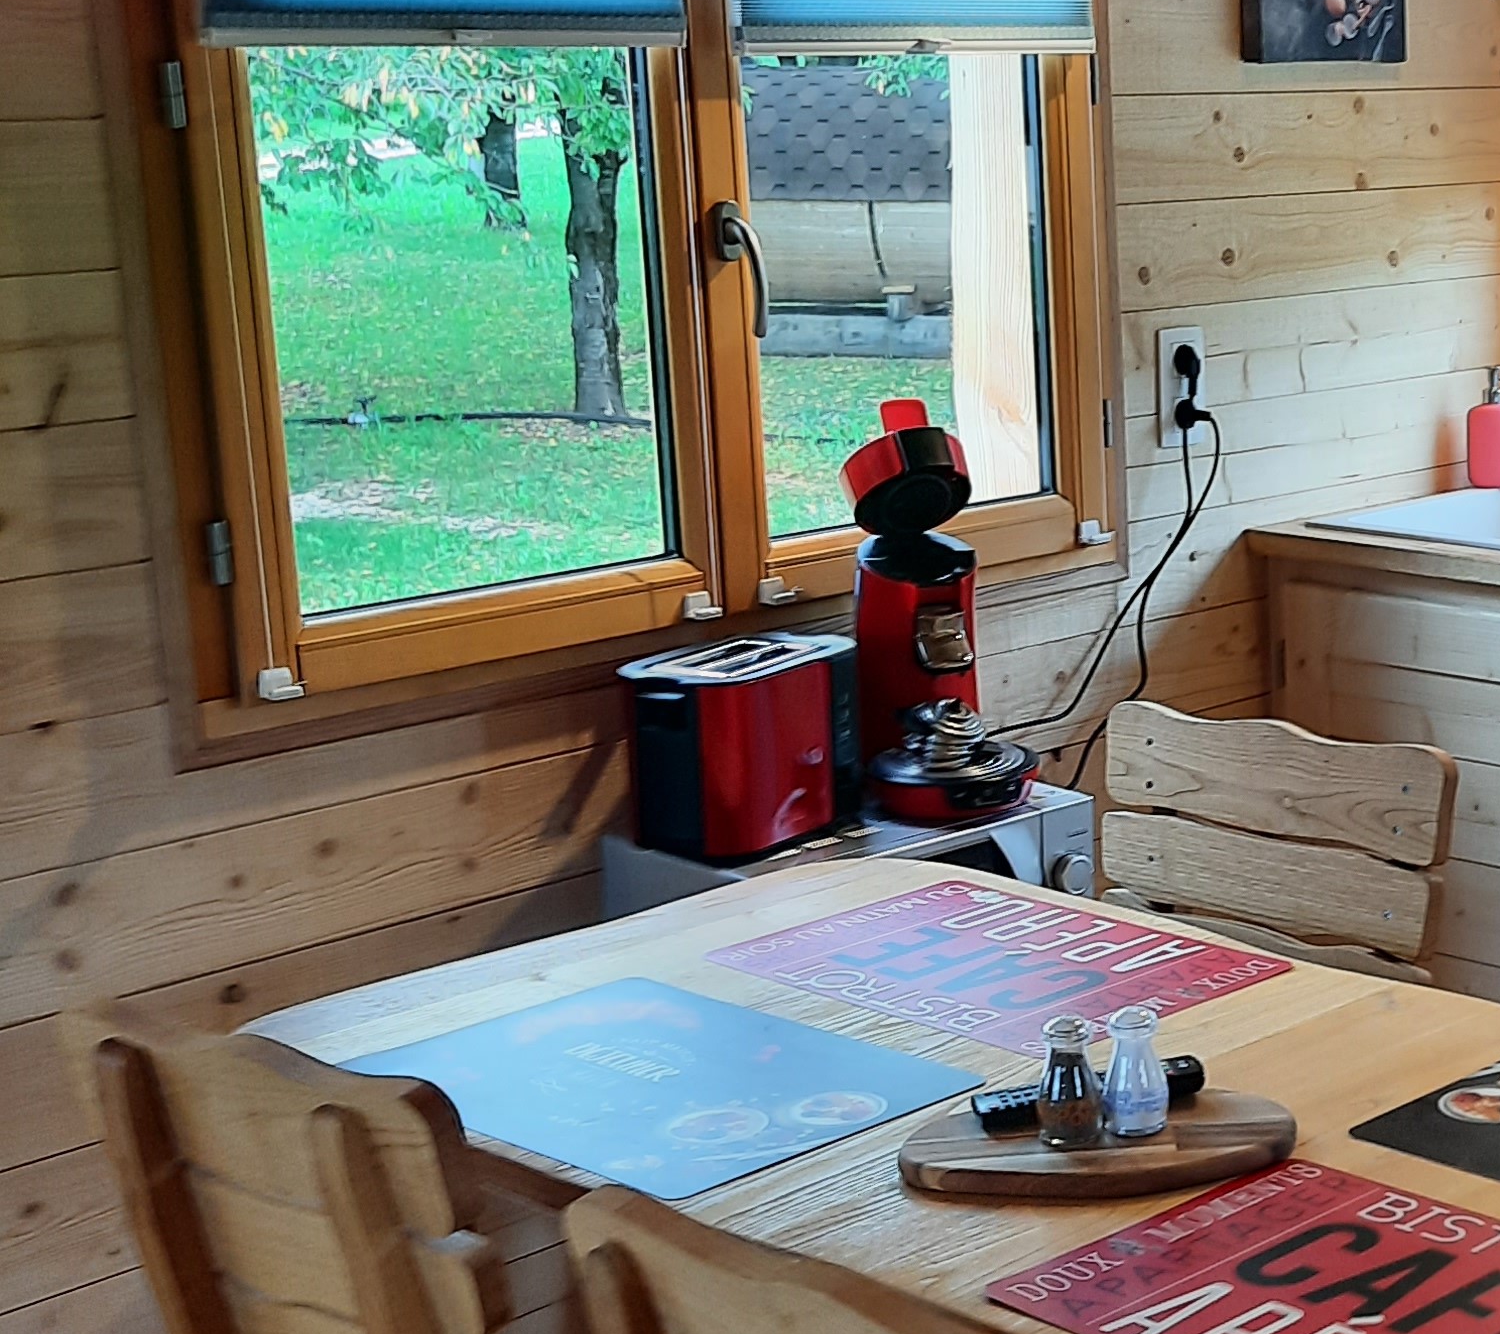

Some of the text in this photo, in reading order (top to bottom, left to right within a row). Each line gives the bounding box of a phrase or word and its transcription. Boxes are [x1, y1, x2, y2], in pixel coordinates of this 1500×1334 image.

[726, 884, 971, 961] DU MATIN AU SOIR
[940, 898, 1206, 973] APÉRO
[1192, 959, 1278, 990] DOUX
[1006, 1163, 1323, 1302] DOUX MOMENTS
